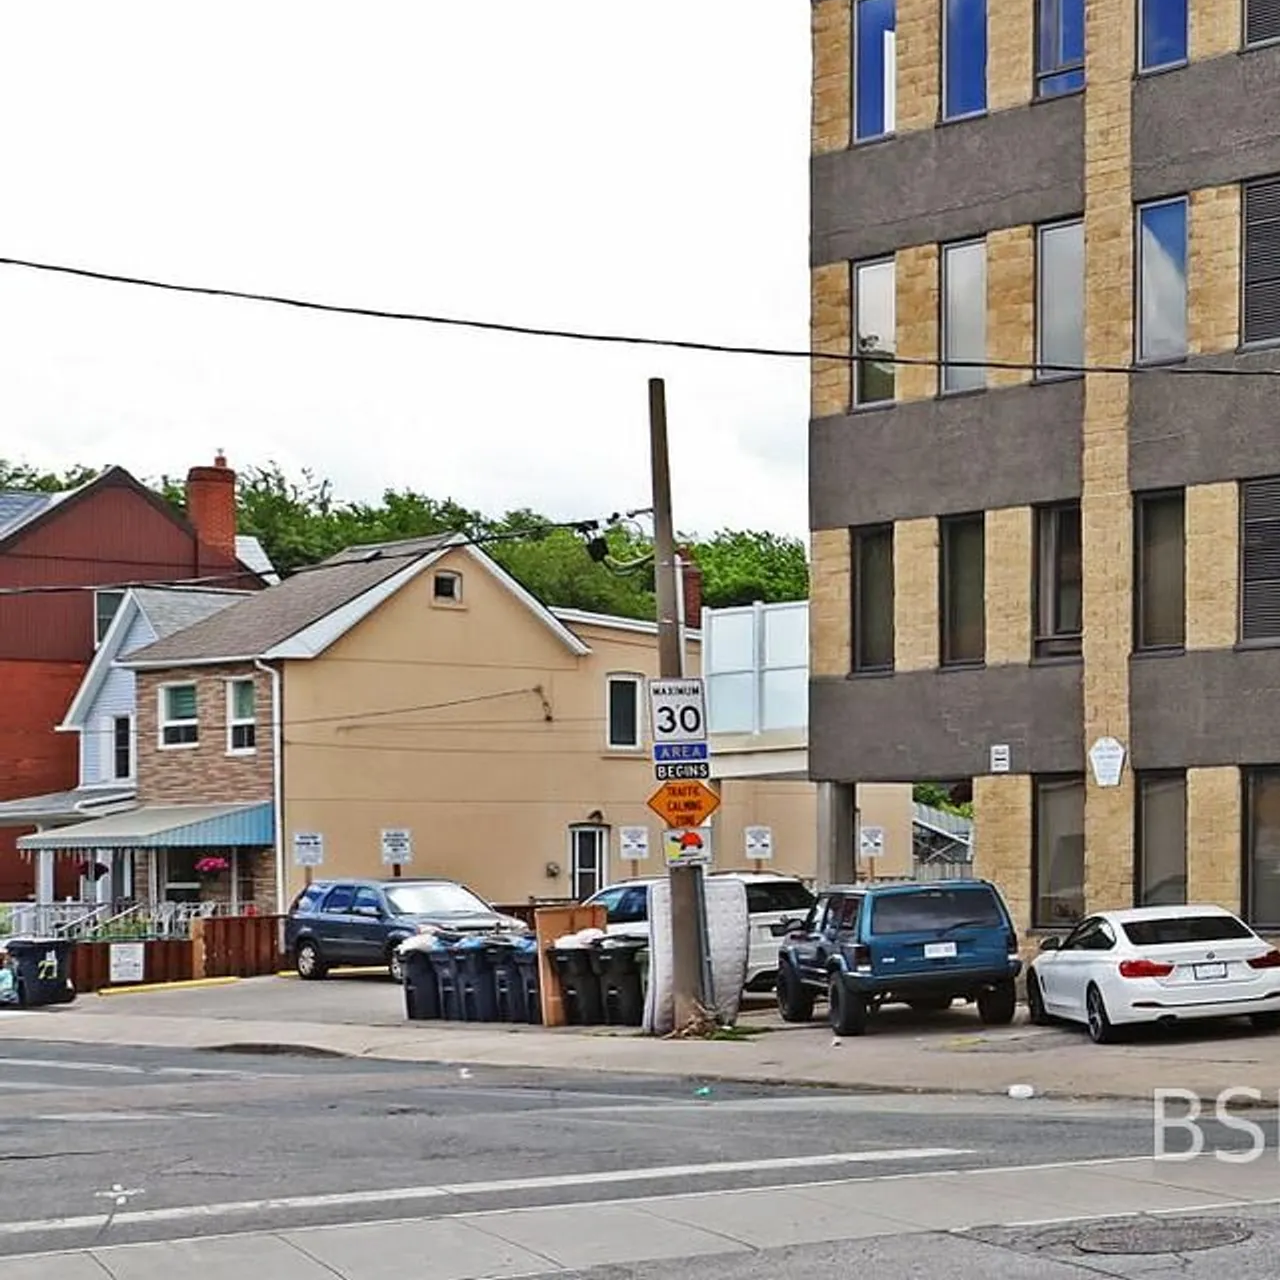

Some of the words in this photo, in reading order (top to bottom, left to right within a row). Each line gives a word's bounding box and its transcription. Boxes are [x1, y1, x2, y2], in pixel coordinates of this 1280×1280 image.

[653, 685, 699, 696] MAXIMUM
[657, 705, 701, 733] 30
[661, 745, 701, 758] AREA
[657, 764, 708, 778] BEGINS
[666, 786, 700, 796] TRAFFIC
[667, 800, 704, 812] CALMING
